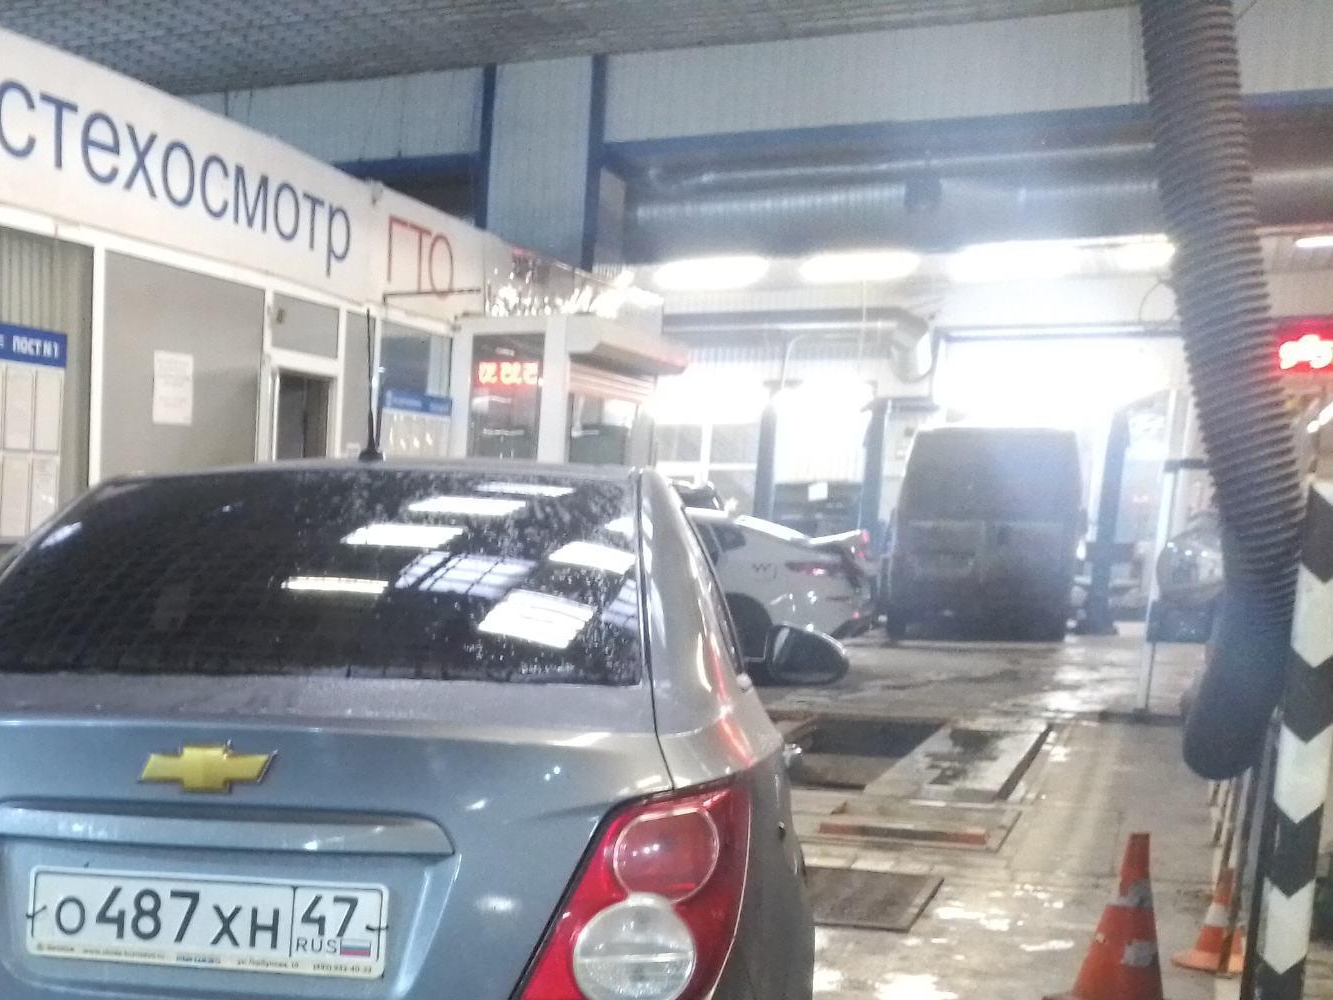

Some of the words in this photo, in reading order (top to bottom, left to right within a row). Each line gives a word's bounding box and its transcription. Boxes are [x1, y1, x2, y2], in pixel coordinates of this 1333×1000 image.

[386, 215, 455, 300] ГТО
[301, 894, 360, 938] 47
[295, 937, 337, 955] RUS
